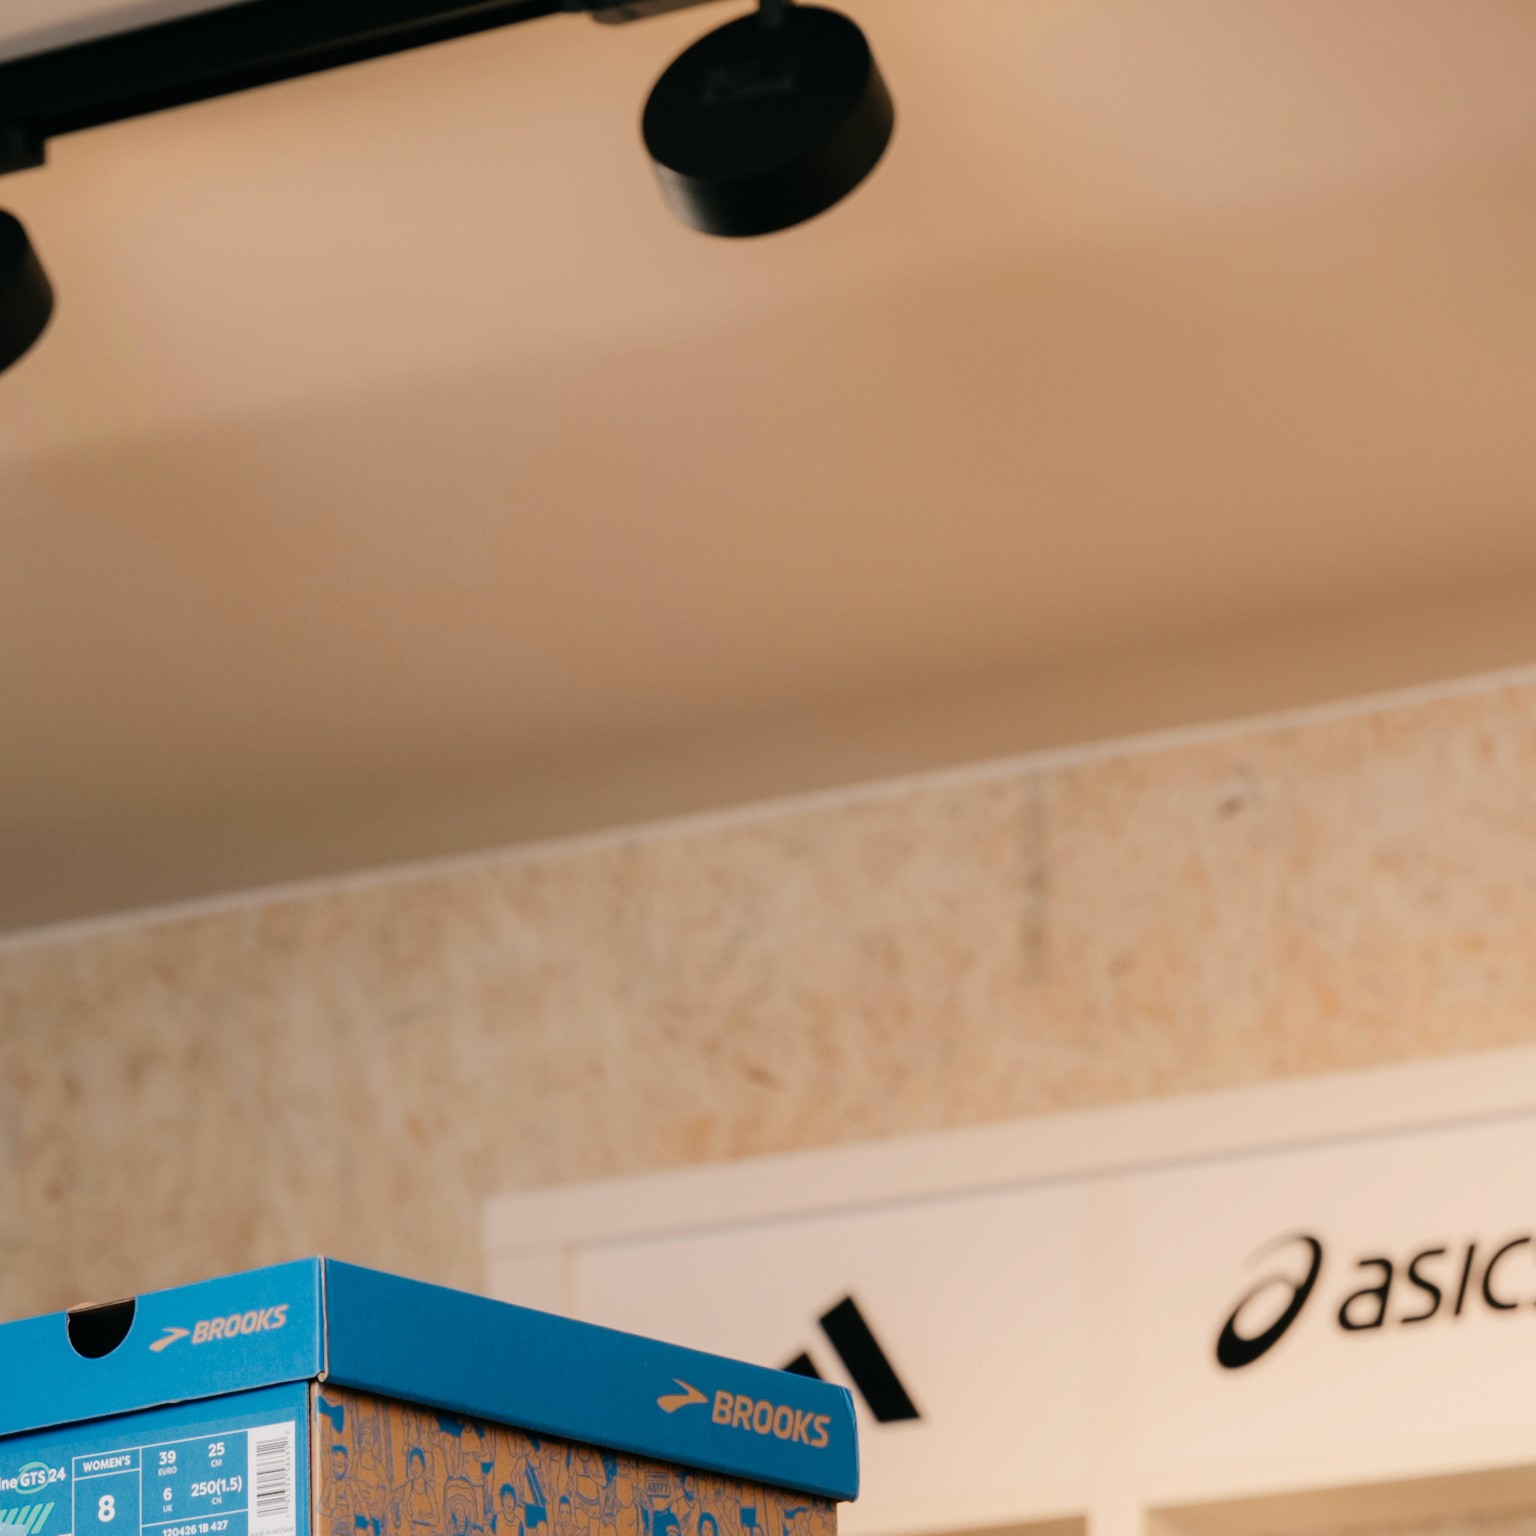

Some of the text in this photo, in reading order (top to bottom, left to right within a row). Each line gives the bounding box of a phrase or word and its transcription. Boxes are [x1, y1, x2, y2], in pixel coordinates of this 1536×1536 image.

[1338, 1236, 1536, 1331] asic
[191, 1304, 289, 1345] BROOKS
[710, 1388, 831, 1448] BROOKS
[159, 1450, 176, 1465] 39
[208, 1442, 225, 1457] 25
[83, 1455, 131, 1472] WOMEN'S
[158, 1466, 177, 1476] EURO
[210, 1459, 222, 1467] CM
[20, 1470, 45, 1487] GTS
[48, 1467, 66, 1482] 24
[163, 1487, 173, 1501] 6
[191, 1475, 242, 1497] 250(1.5)
[98, 1495, 115, 1522] 8
[210, 1520, 228, 1531] 427
